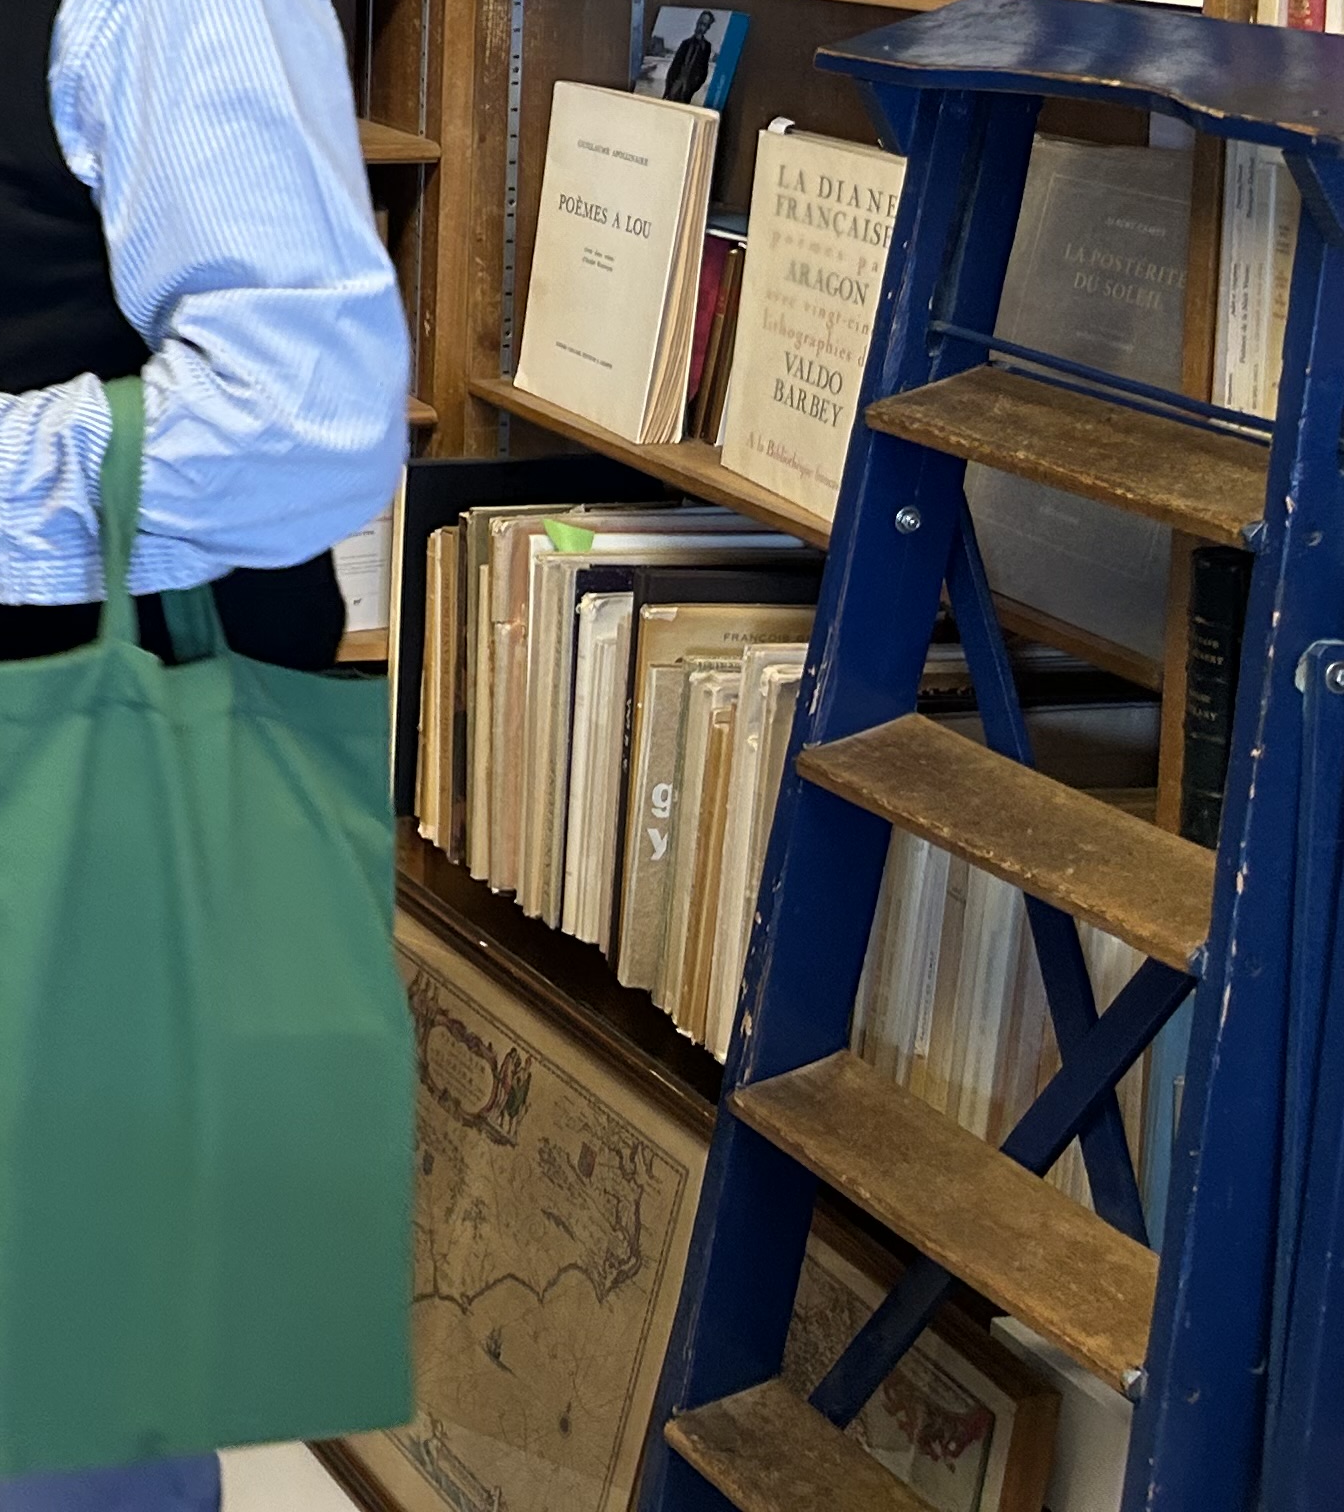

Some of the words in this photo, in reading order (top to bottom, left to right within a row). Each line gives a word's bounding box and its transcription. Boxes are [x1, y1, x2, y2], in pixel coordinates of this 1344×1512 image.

[611, 148, 650, 167] APOLLINAIRE
[777, 164, 806, 195] LA
[817, 176, 899, 219] DIANE
[558, 193, 609, 226] POÈMES
[611, 211, 621, 230] A
[625, 214, 653, 240] LOU
[774, 193, 895, 249] FRANÇAISE
[770, 231, 844, 262] poèmes
[856, 255, 879, 277] pa
[1064, 242, 1087, 265] LA
[1089, 247, 1188, 290] POSTÉRITÉ
[784, 258, 870, 308] ARAGON
[1073, 270, 1100, 294] DU
[1103, 276, 1162, 311] SOLEIL
[762, 306, 852, 363] lithographies
[765, 289, 796, 310] avec
[803, 298, 870, 337] vingt-cin
[784, 350, 844, 396] VALDO
[772, 377, 844, 428] BARBEY
[745, 431, 755, 450] A
[765, 439, 816, 480] Bibliothèque
